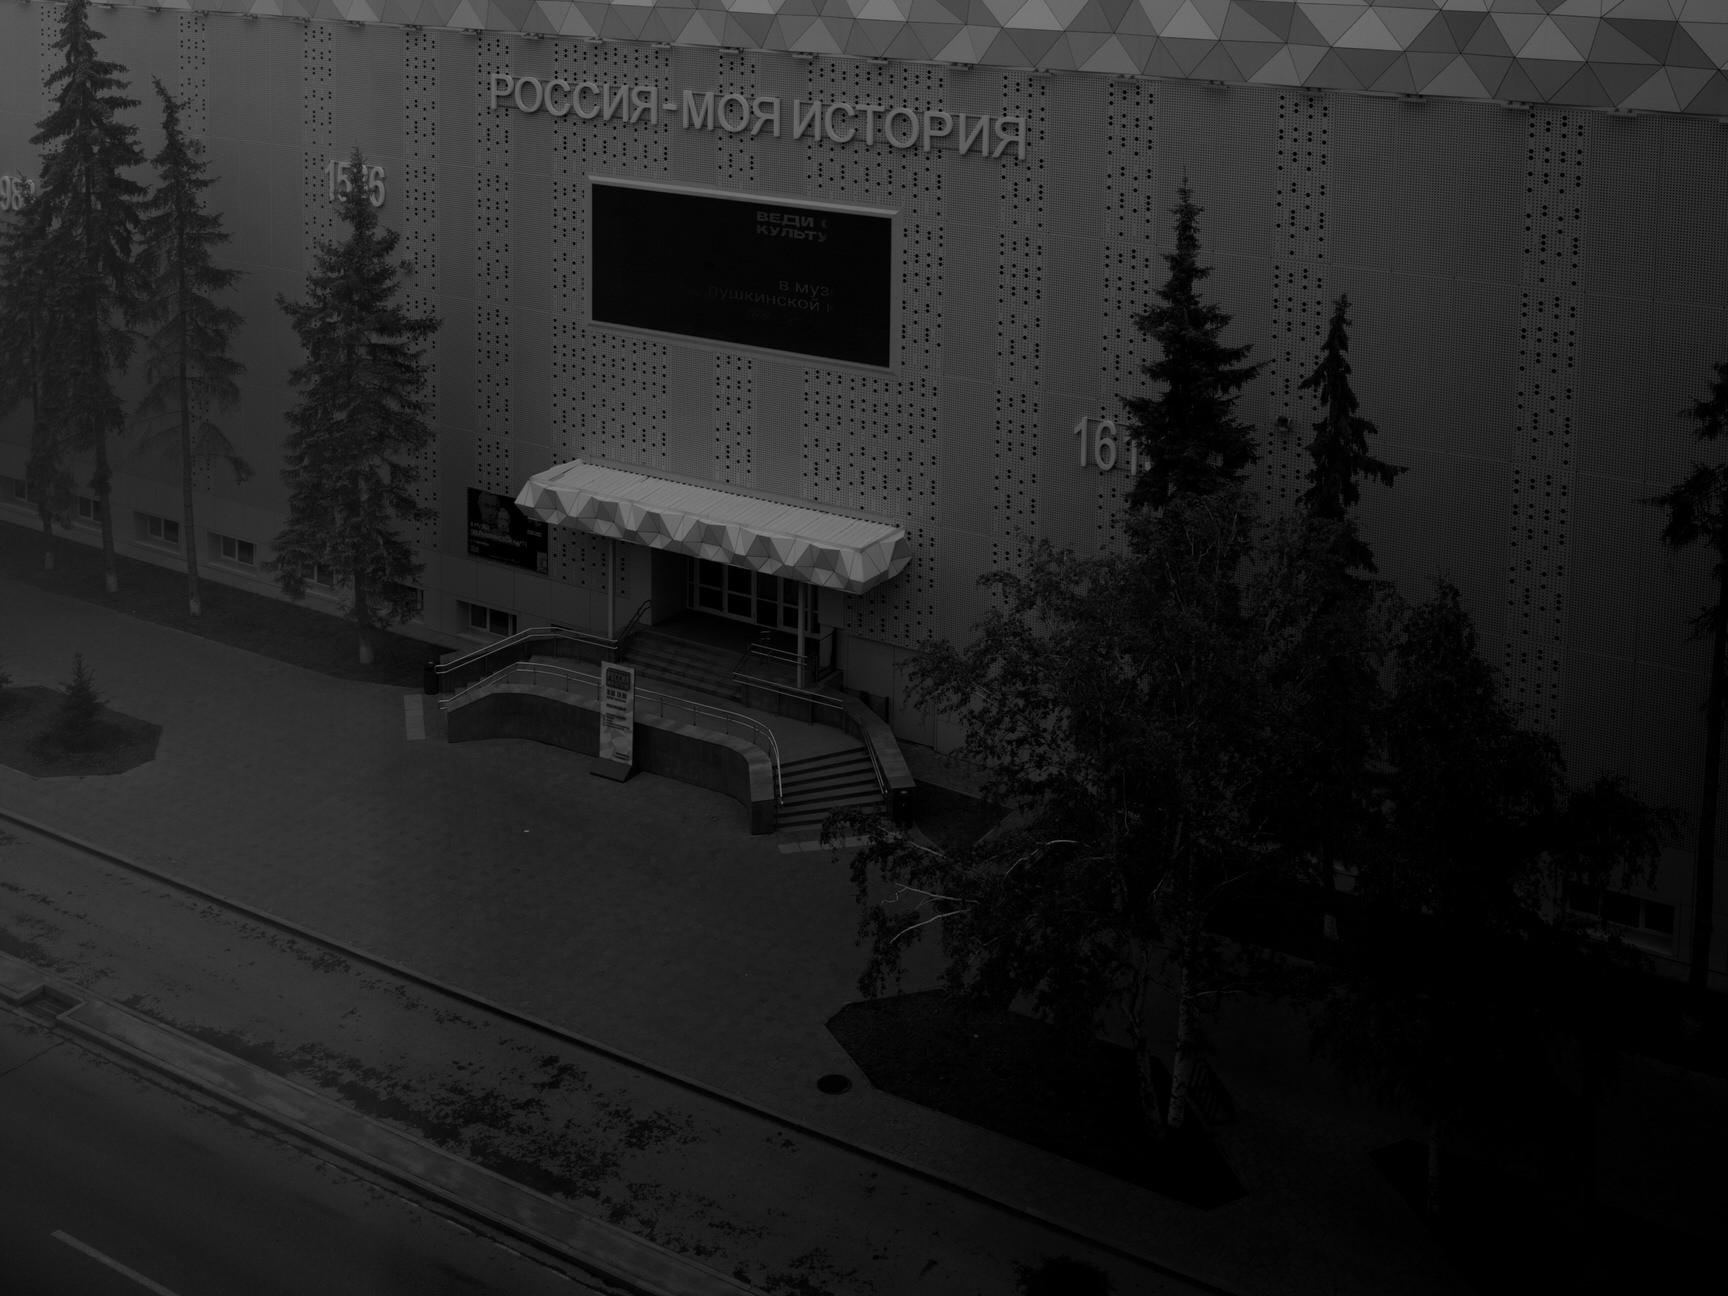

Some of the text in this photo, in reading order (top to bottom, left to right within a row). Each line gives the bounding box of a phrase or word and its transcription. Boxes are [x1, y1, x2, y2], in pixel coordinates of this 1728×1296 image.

[793, 99, 1027, 161] ИСТОРИЯ
[756, 211, 814, 227] ВЕДИ
[1073, 417, 1152, 476] 161
